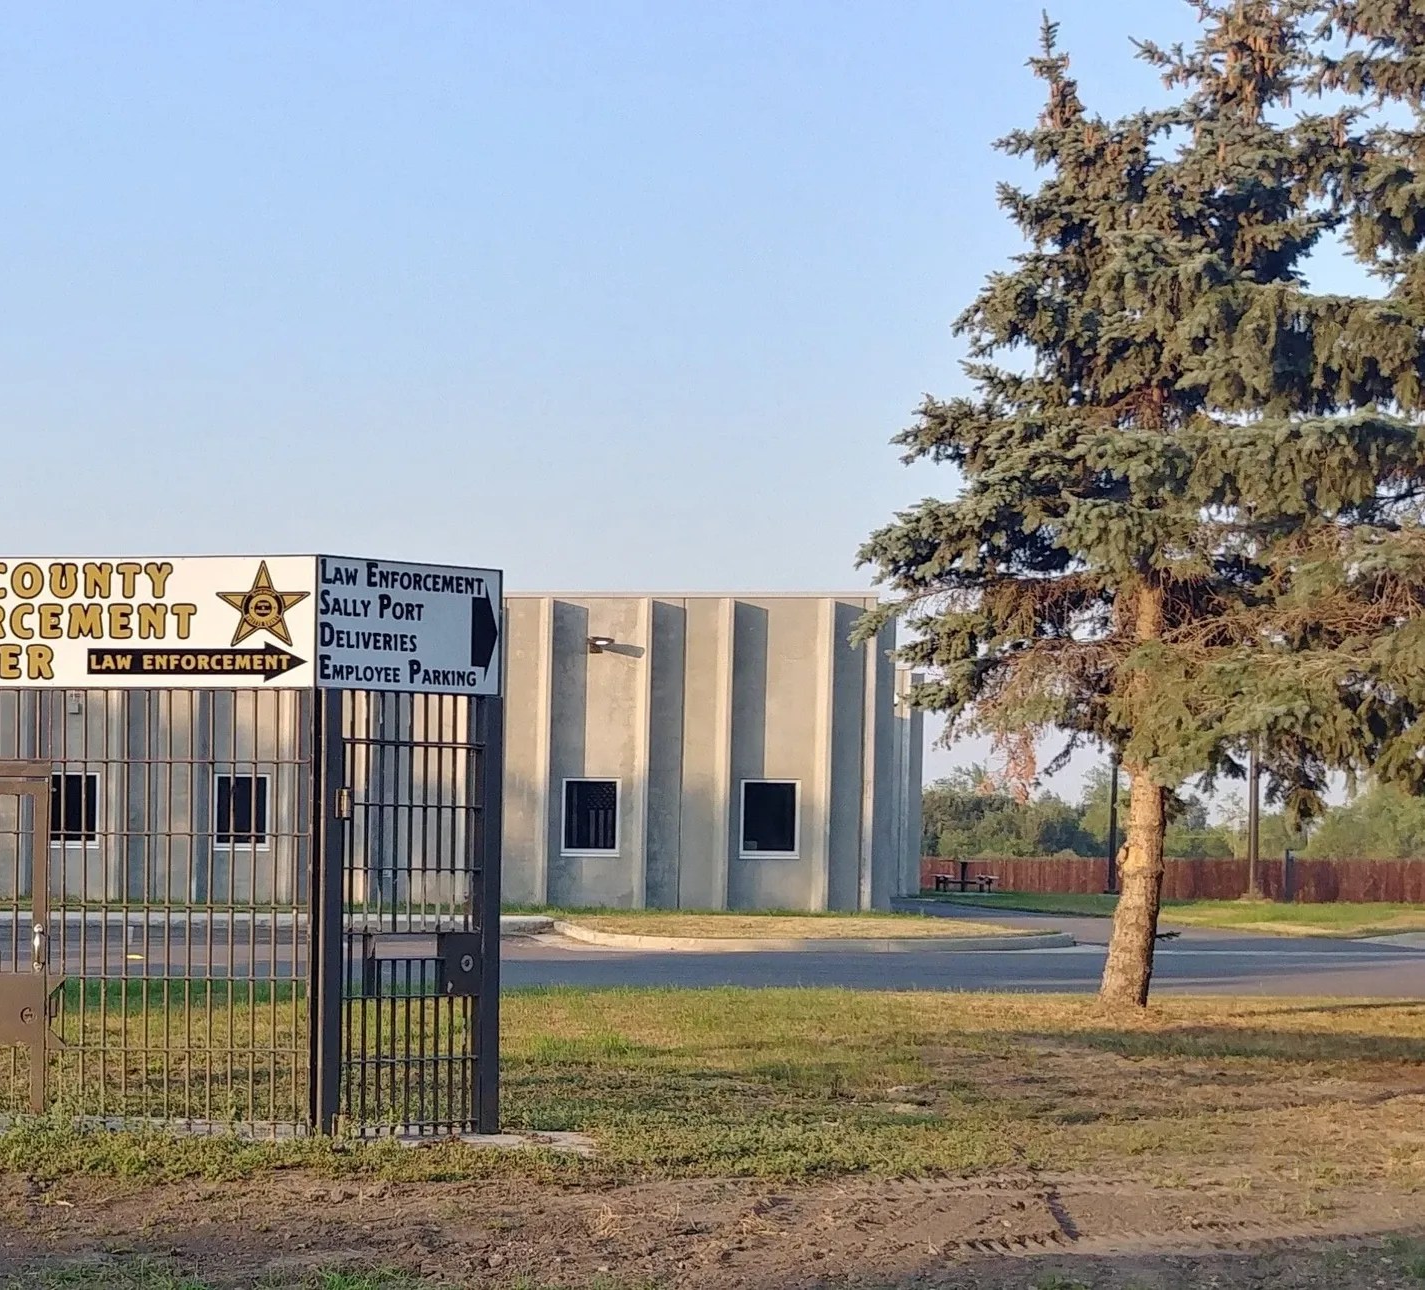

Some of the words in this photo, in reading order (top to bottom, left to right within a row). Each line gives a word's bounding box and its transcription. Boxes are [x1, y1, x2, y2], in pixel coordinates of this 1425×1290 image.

[321, 558, 358, 586] LAW
[366, 562, 484, 596] ENFORCEMENT
[319, 589, 371, 618] SALLY
[378, 594, 424, 621] PORT
[319, 622, 417, 652] DELIVERIES
[89, 654, 133, 670] LAW
[142, 654, 291, 671] ENFORCEMENT
[319, 655, 401, 683] EMPLOYEE
[408, 659, 477, 687] PARKING
